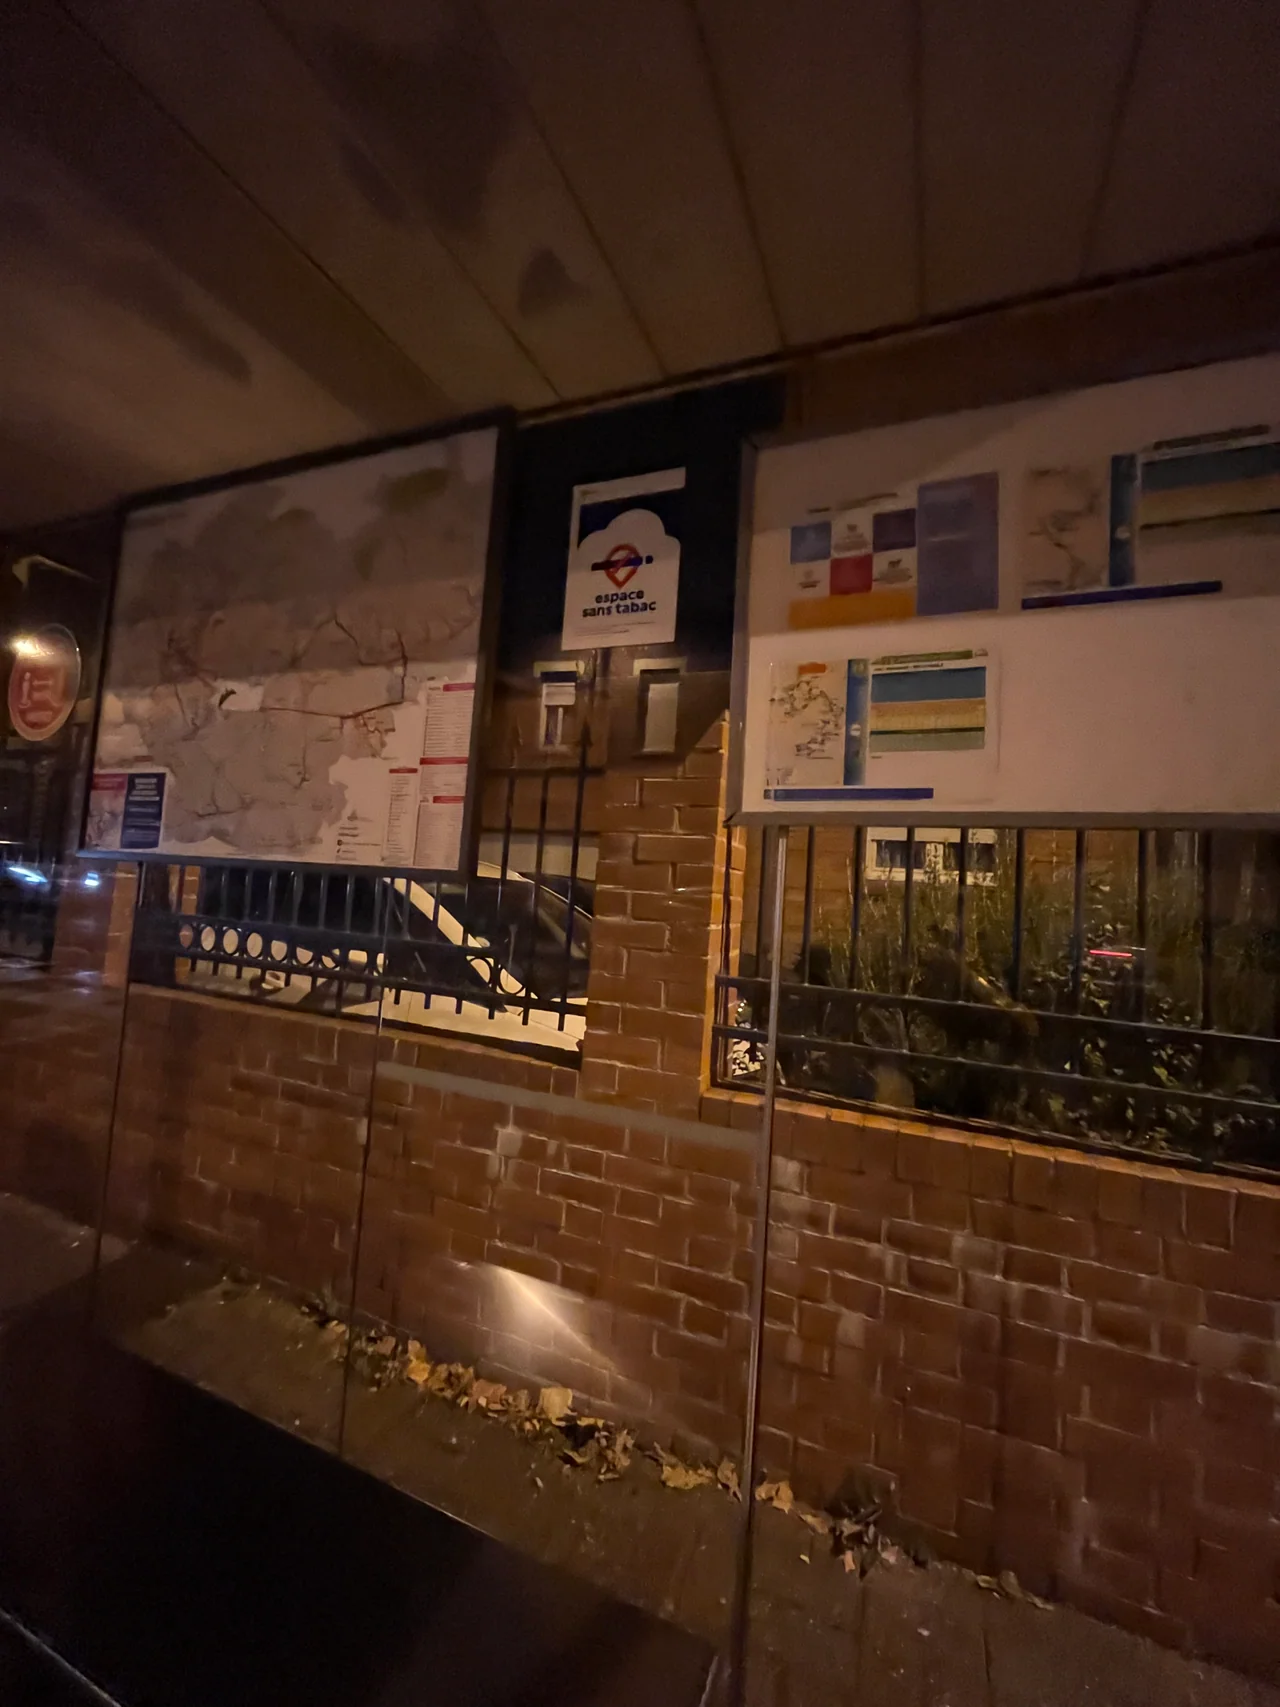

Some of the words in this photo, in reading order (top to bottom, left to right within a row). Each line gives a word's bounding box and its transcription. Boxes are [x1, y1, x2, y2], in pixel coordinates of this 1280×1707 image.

[595, 590, 644, 604] espace
[582, 606, 612, 617] sans
[616, 600, 656, 614] tabac
